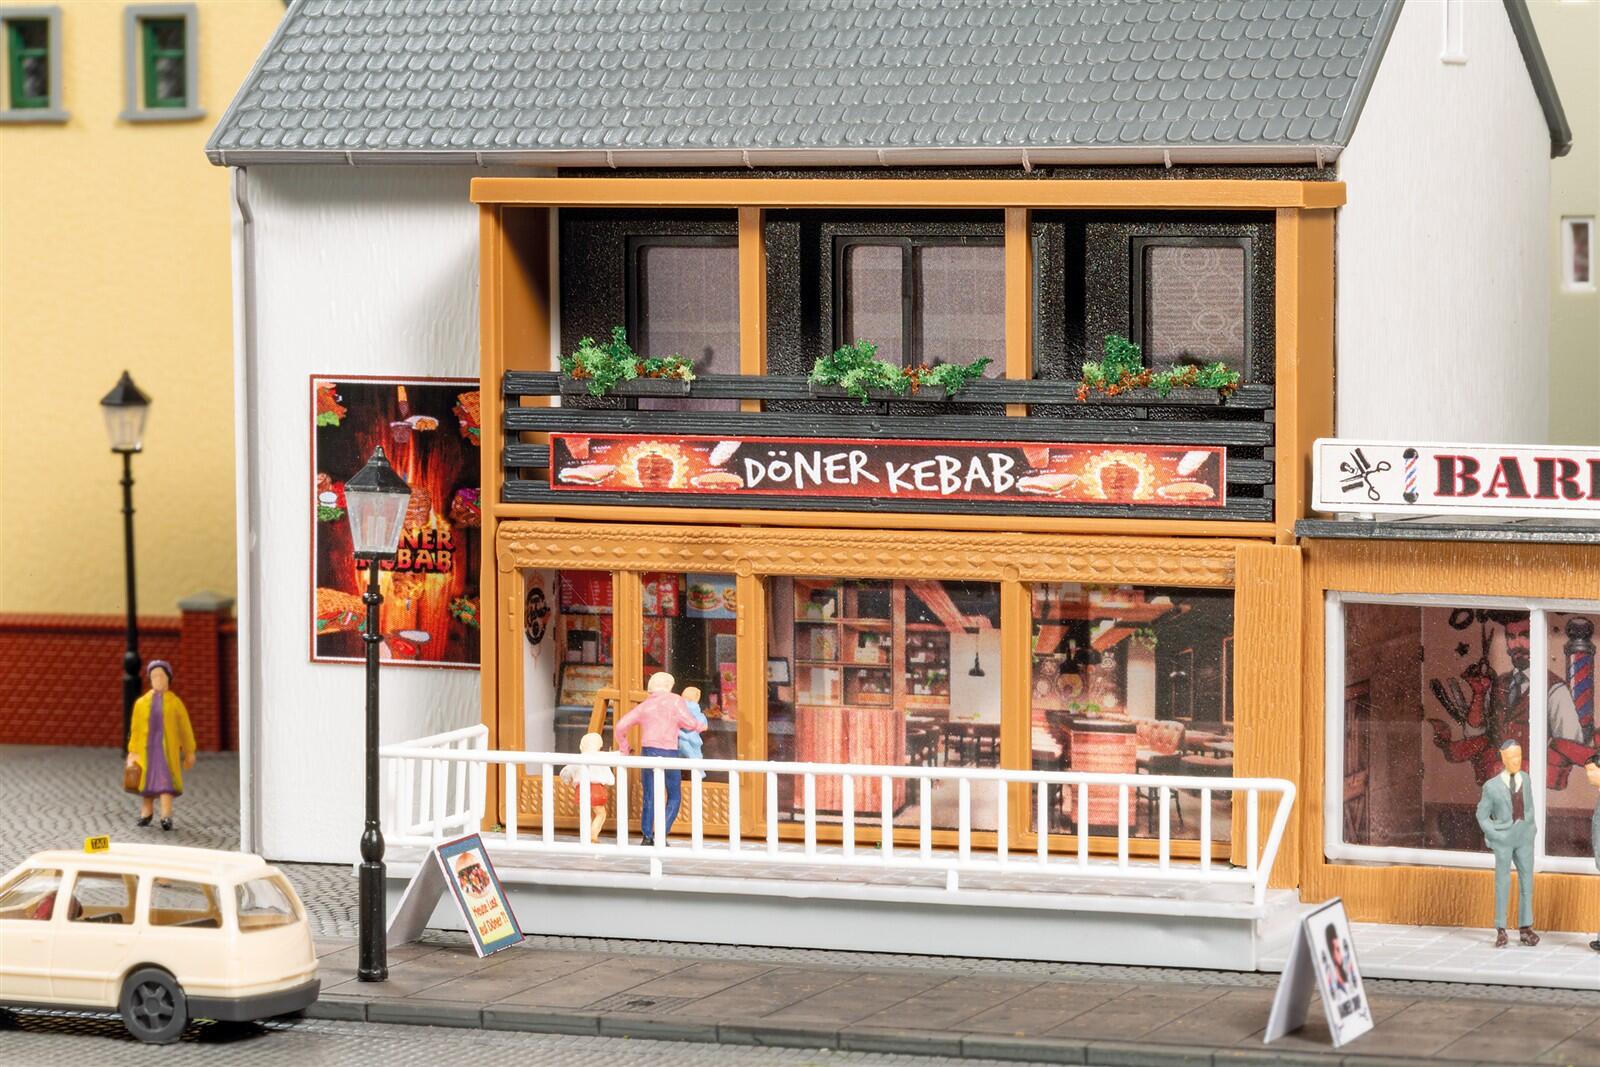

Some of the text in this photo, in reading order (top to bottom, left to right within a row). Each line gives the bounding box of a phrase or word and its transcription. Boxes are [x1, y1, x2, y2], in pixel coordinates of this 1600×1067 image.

[744, 450, 1016, 495] DÖNER KEBAB
[398, 528, 455, 550] NER
[357, 548, 453, 574] BAB
[91, 837, 109, 849] TAXI
